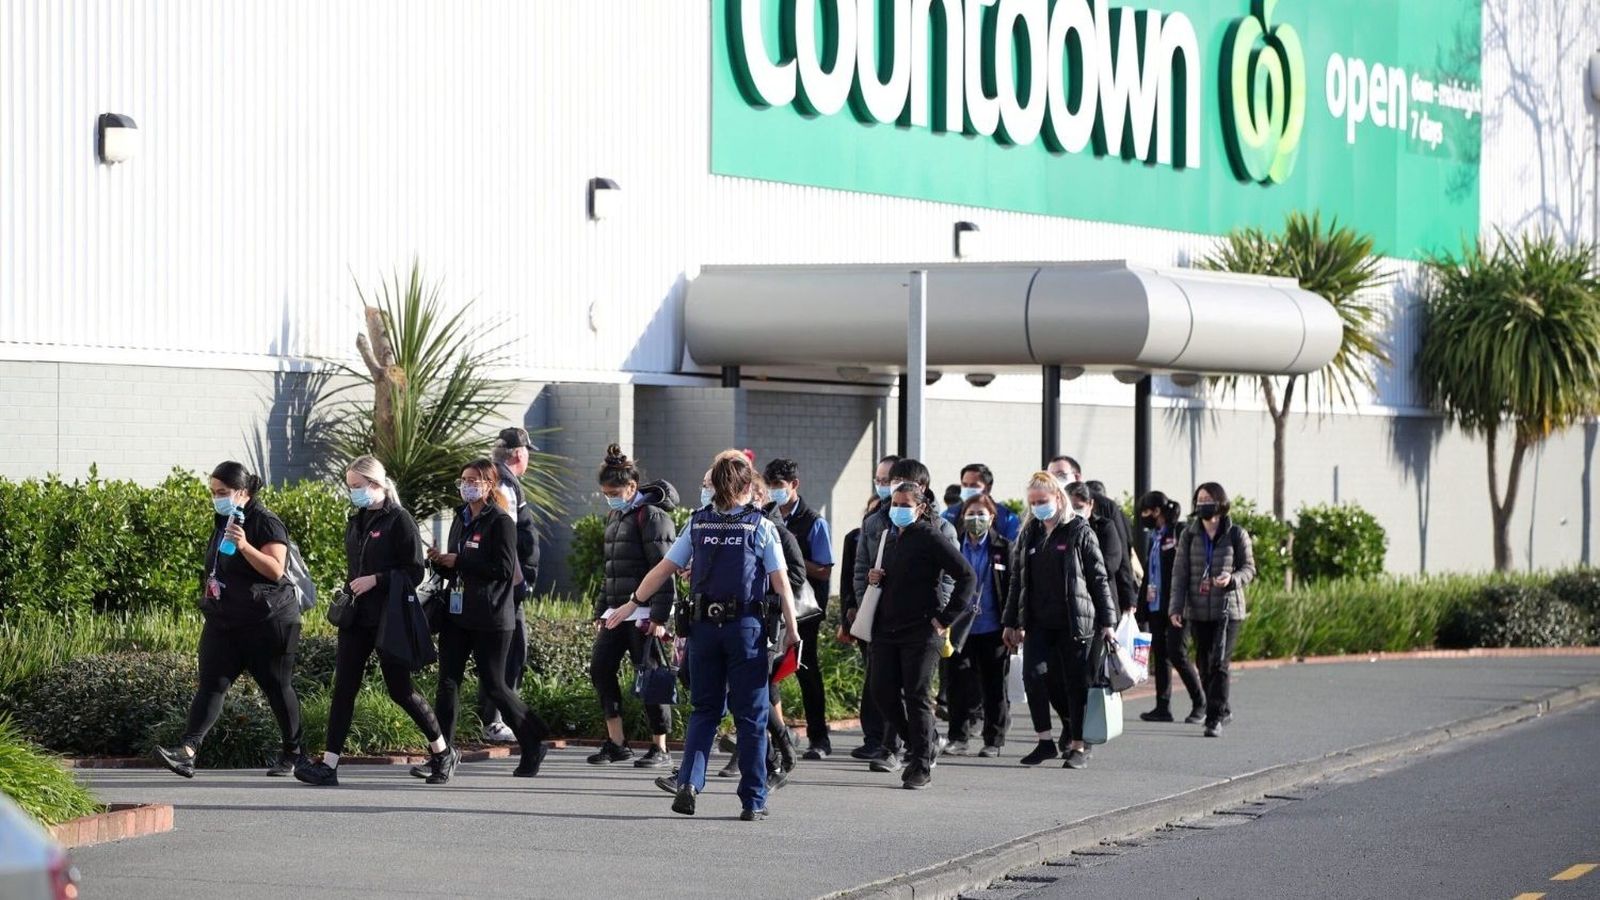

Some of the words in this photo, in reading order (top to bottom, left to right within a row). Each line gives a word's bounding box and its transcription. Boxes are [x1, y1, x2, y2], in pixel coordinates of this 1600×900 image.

[1326, 53, 1407, 144] open
[1411, 110, 1419, 139] 7
[1419, 110, 1443, 150] days
